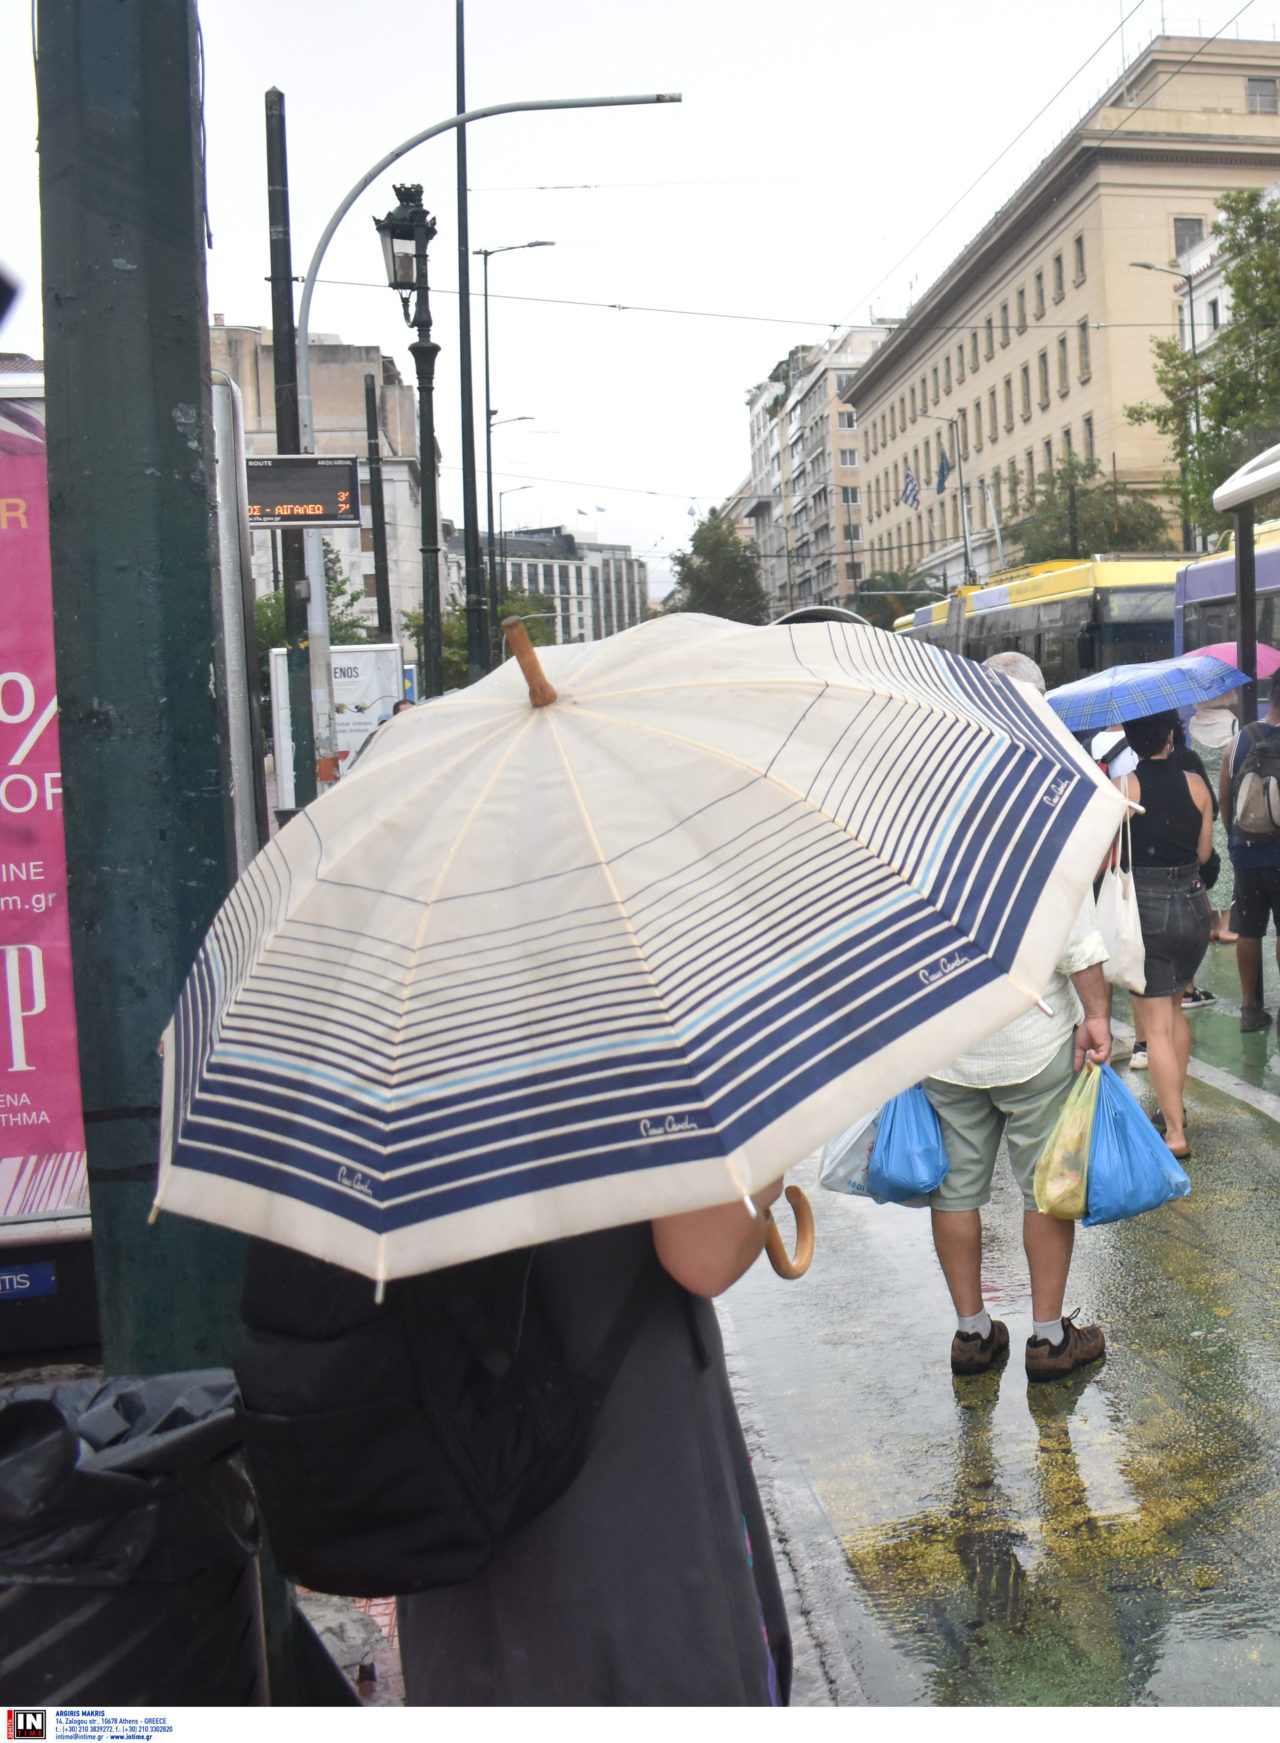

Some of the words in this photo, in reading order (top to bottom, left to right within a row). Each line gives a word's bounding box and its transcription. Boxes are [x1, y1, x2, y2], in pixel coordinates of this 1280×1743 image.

[275, 504, 324, 515] ΑΙΓΑΛΕΩ
[333, 666, 359, 679] ENOS
[1, 861, 46, 882] INE
[0, 892, 56, 913] m.gr
